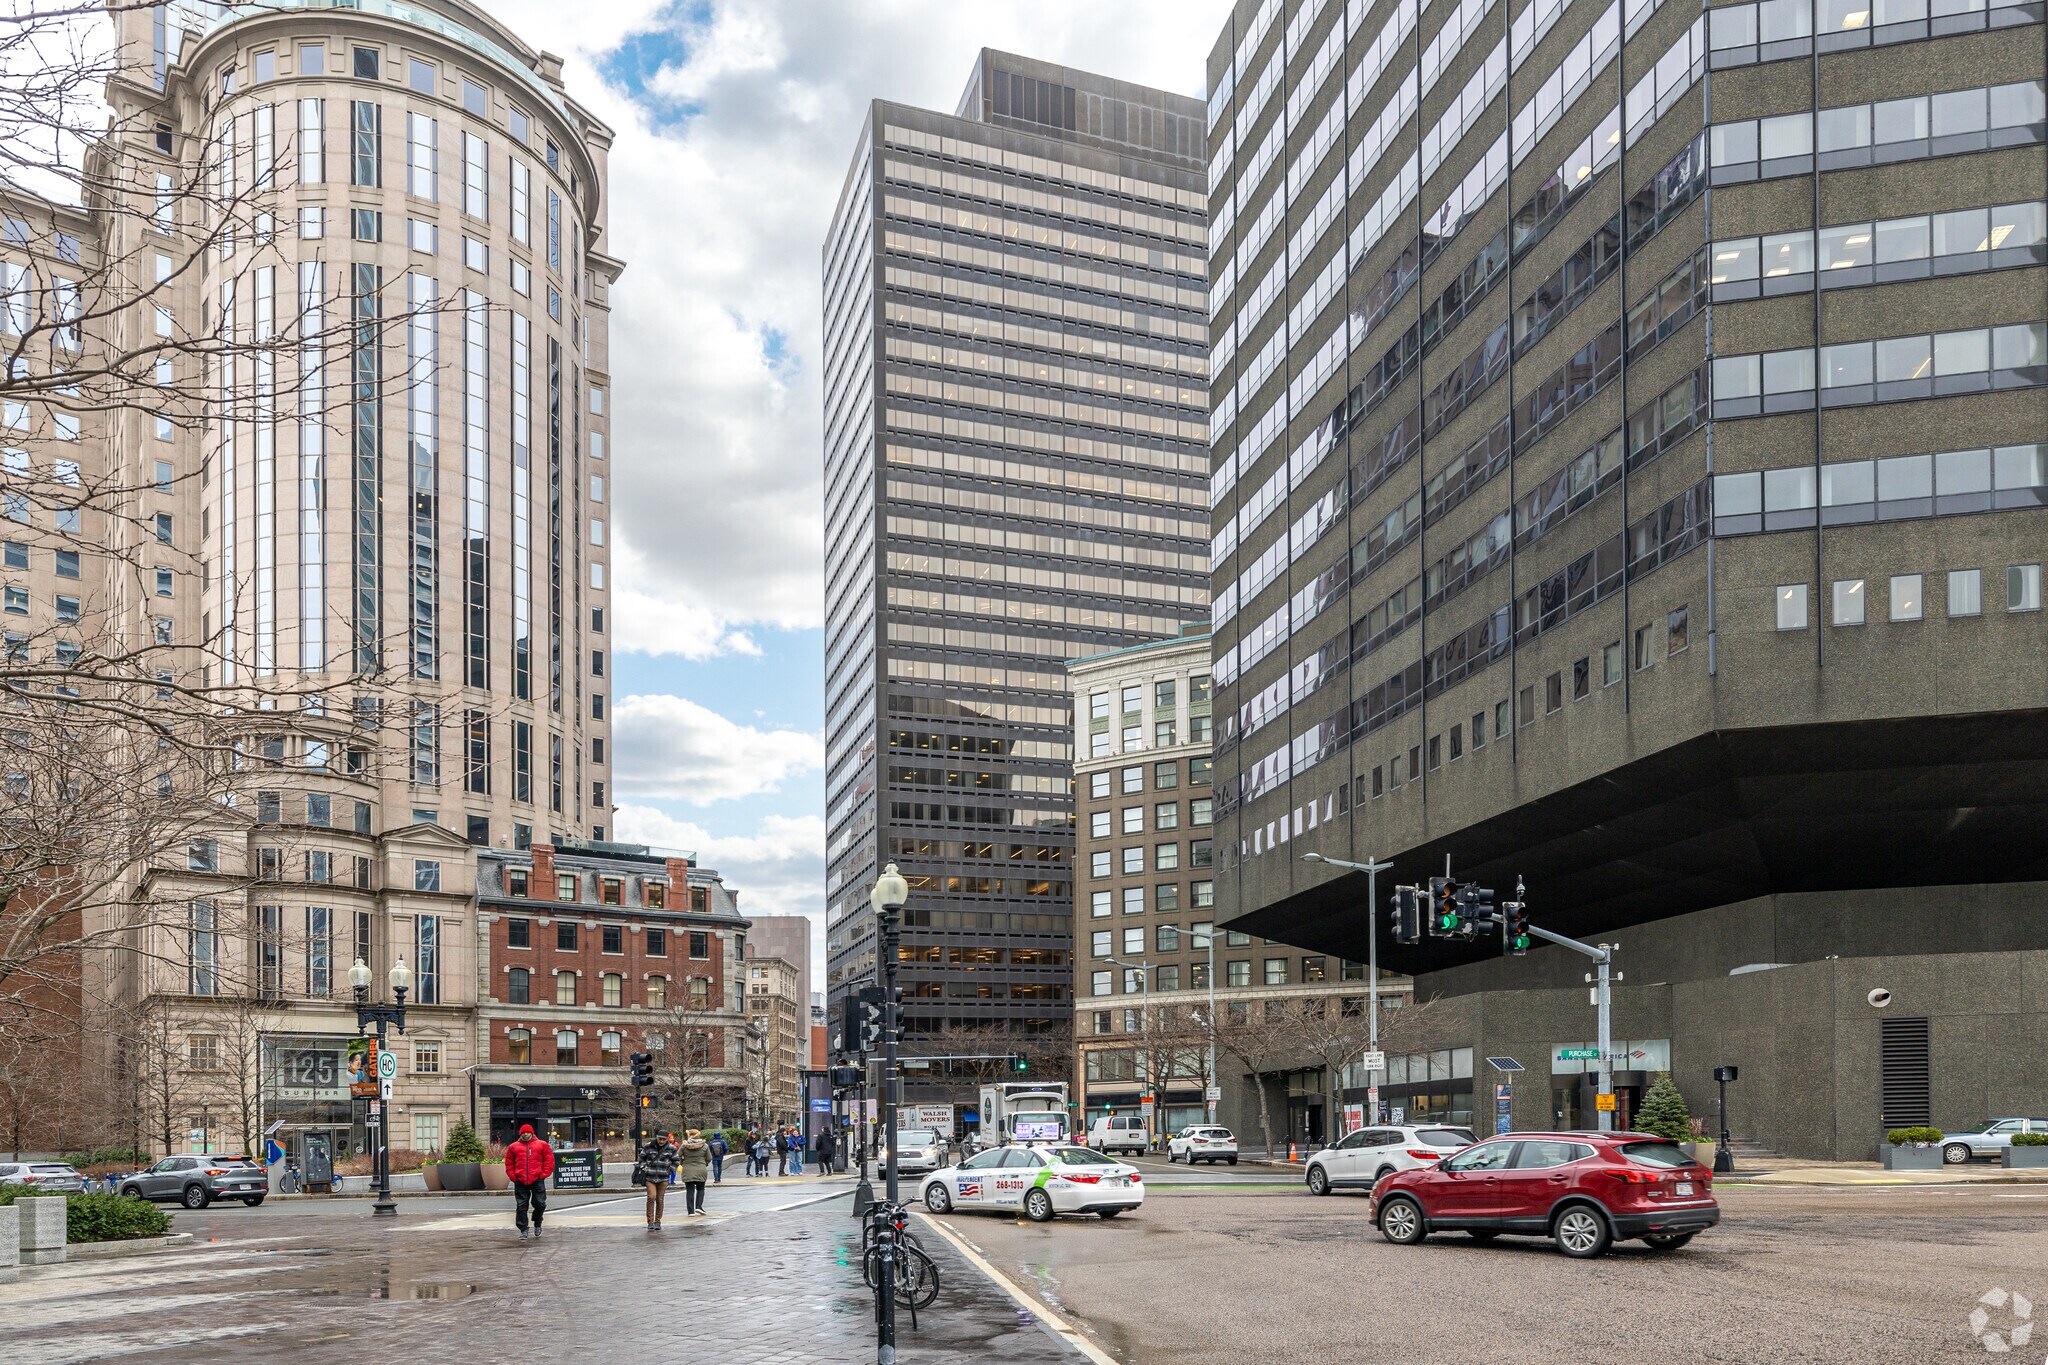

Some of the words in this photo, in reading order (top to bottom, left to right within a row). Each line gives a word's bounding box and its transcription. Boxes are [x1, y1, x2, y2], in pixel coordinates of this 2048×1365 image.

[369, 1038, 377, 1078] GATHER
[382, 1058, 392, 1072] HC
[291, 1056, 333, 1084] 125
[956, 1175, 984, 1183] INDEPENDENT
[996, 1180, 1024, 1190] 268-1313
